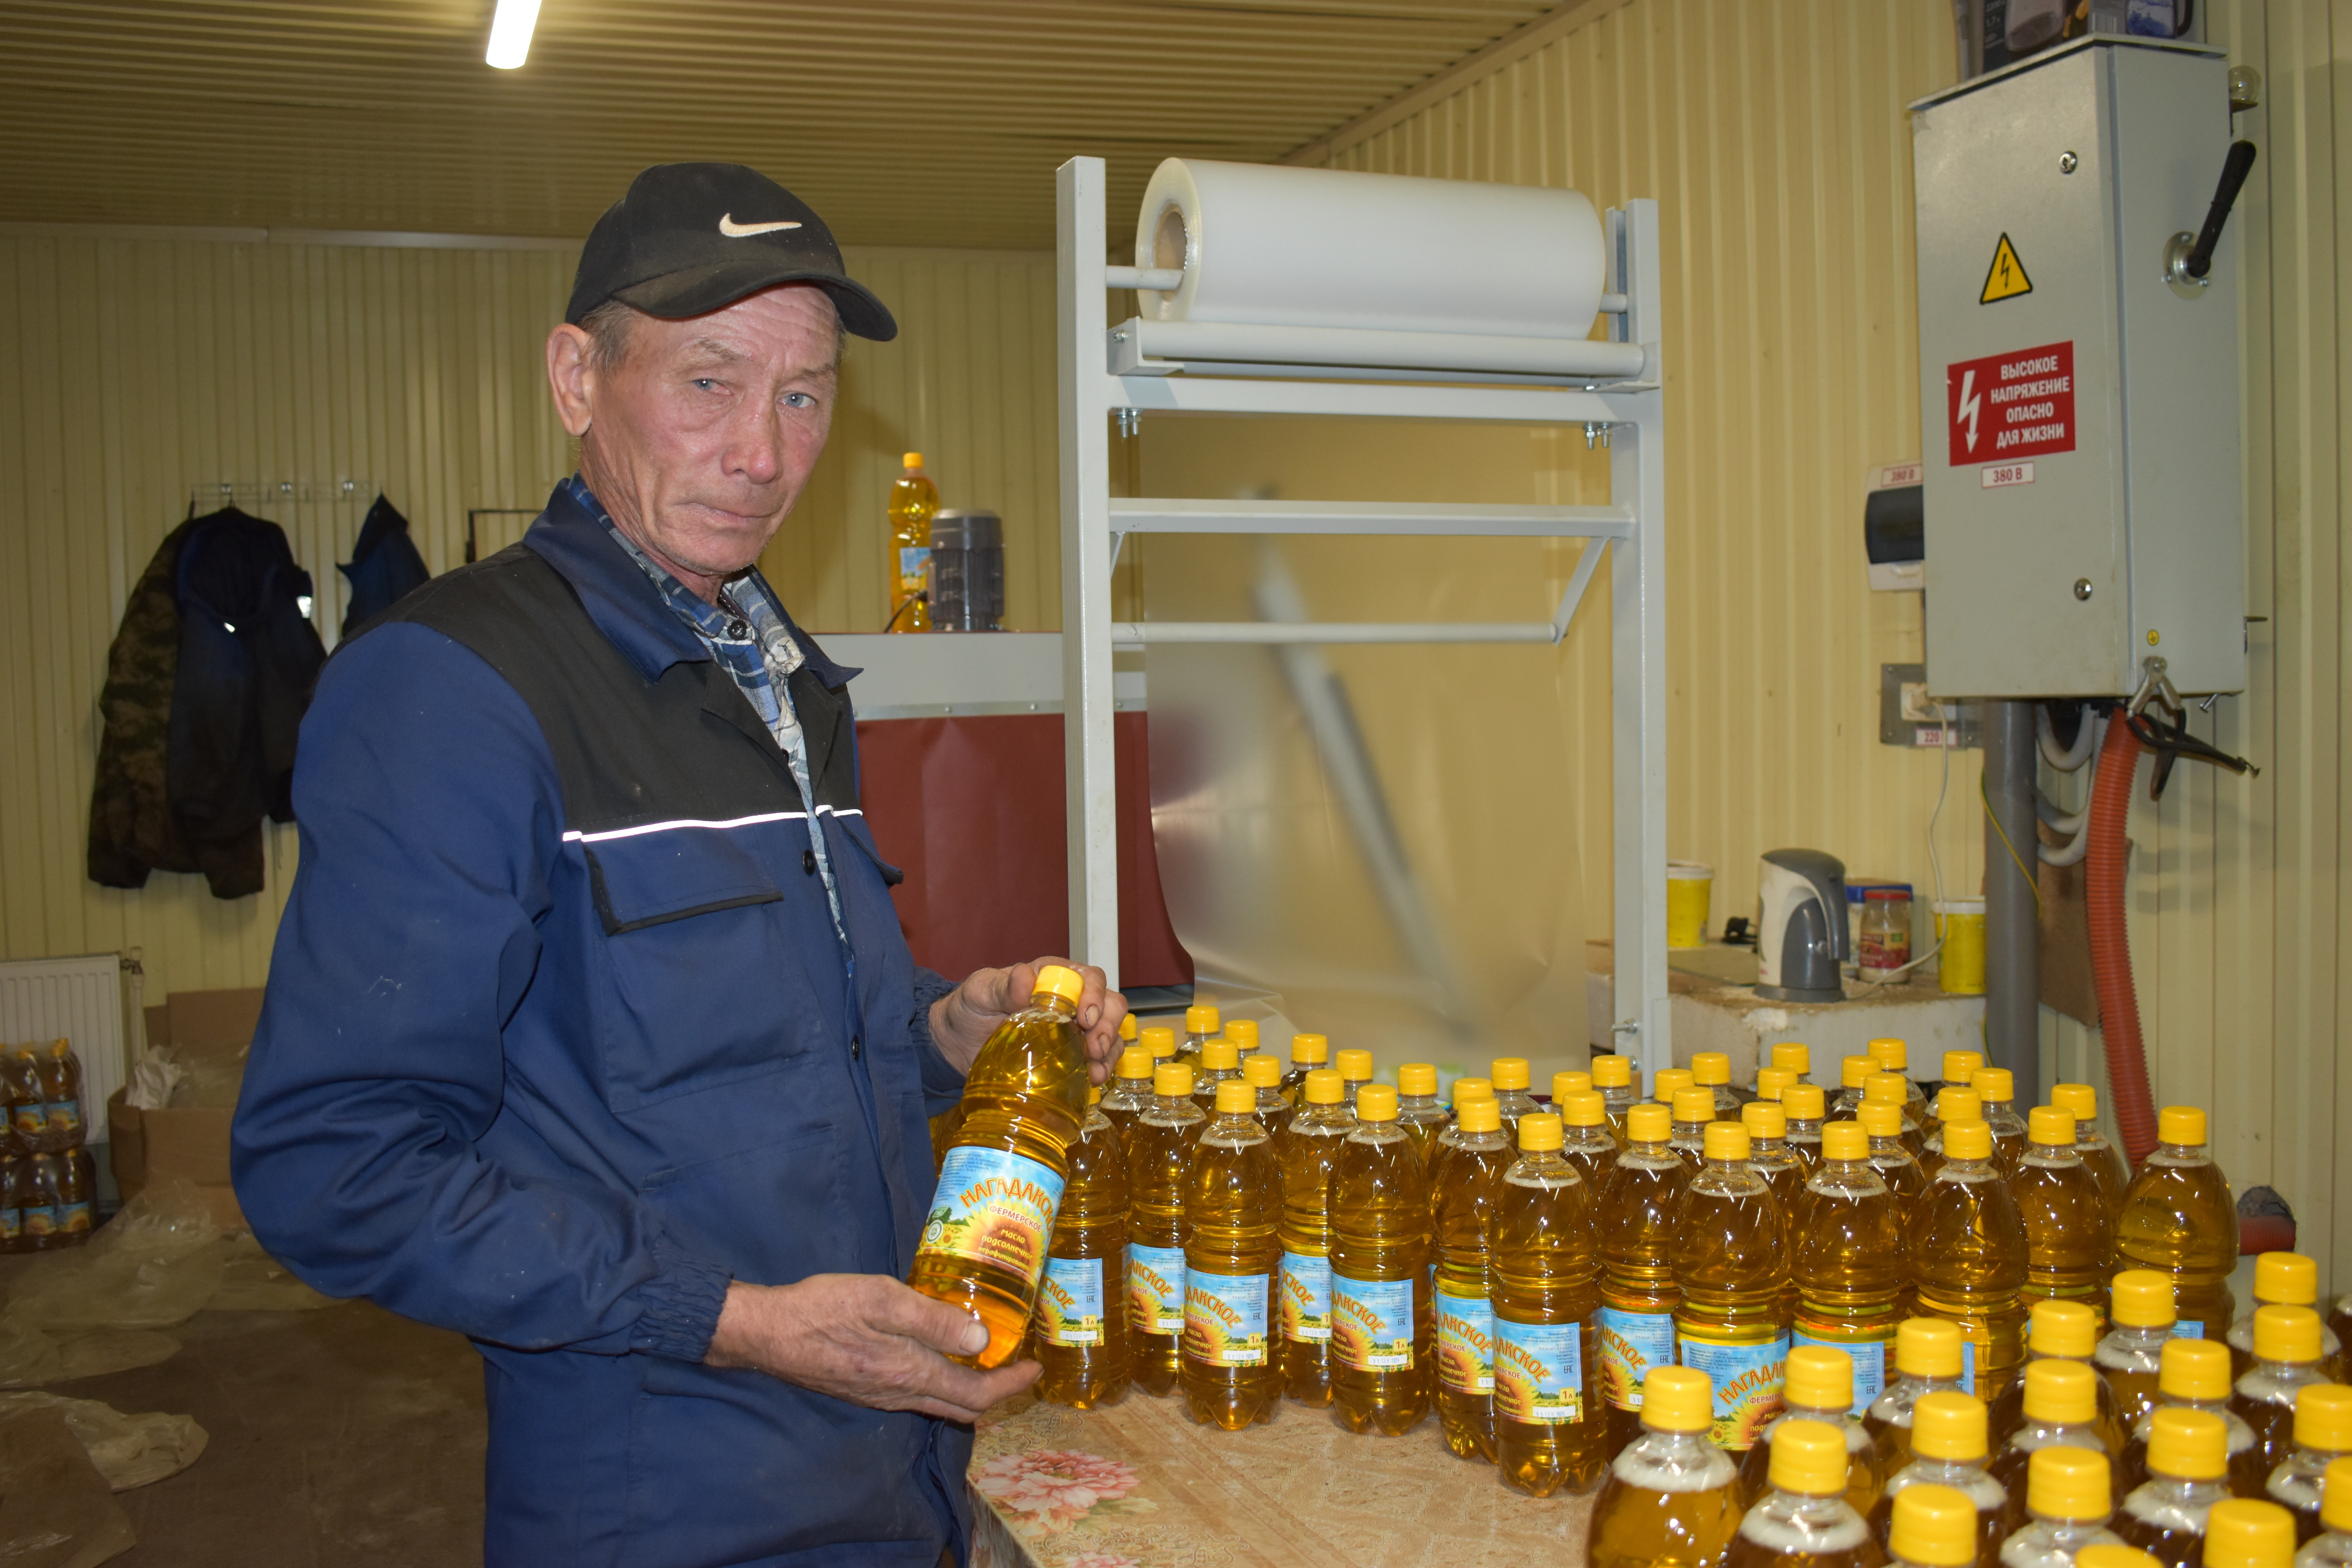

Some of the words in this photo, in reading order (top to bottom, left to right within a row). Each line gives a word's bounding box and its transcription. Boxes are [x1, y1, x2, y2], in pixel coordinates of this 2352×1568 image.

[2001, 355, 2058, 380] ВЫСОКОЕ
[1991, 376, 2070, 404] НАПРЯЖЕНИЕ
[2006, 402, 2054, 423] ОПАСНО
[1996, 429, 2019, 450] ДЛЯ
[2021, 423, 2064, 443] ЖИЗНИ
[1993, 469, 2013, 483] 380
[2016, 467, 2022, 480] В
[1924, 731, 1938, 742] 220
[960, 1176, 1054, 1232] НАГАДАКСКО
[989, 1205, 1042, 1232] ФЕРМЕРСКОЕ
[1001, 1229, 1025, 1244] масло
[982, 1235, 1033, 1261] подсолнечное
[1398, 1318, 1406, 1326] EAC
[1188, 1328, 1201, 1338] масло
[1334, 1332, 1347, 1342] масло
[1396, 1341, 1400, 1349] 1
[1441, 1356, 1455, 1365] масло
[1564, 1365, 1573, 1373] EAC
[1496, 1383, 1509, 1392] масло
[1866, 1385, 1876, 1394] EAC
[1563, 1390, 1567, 1399] 1
